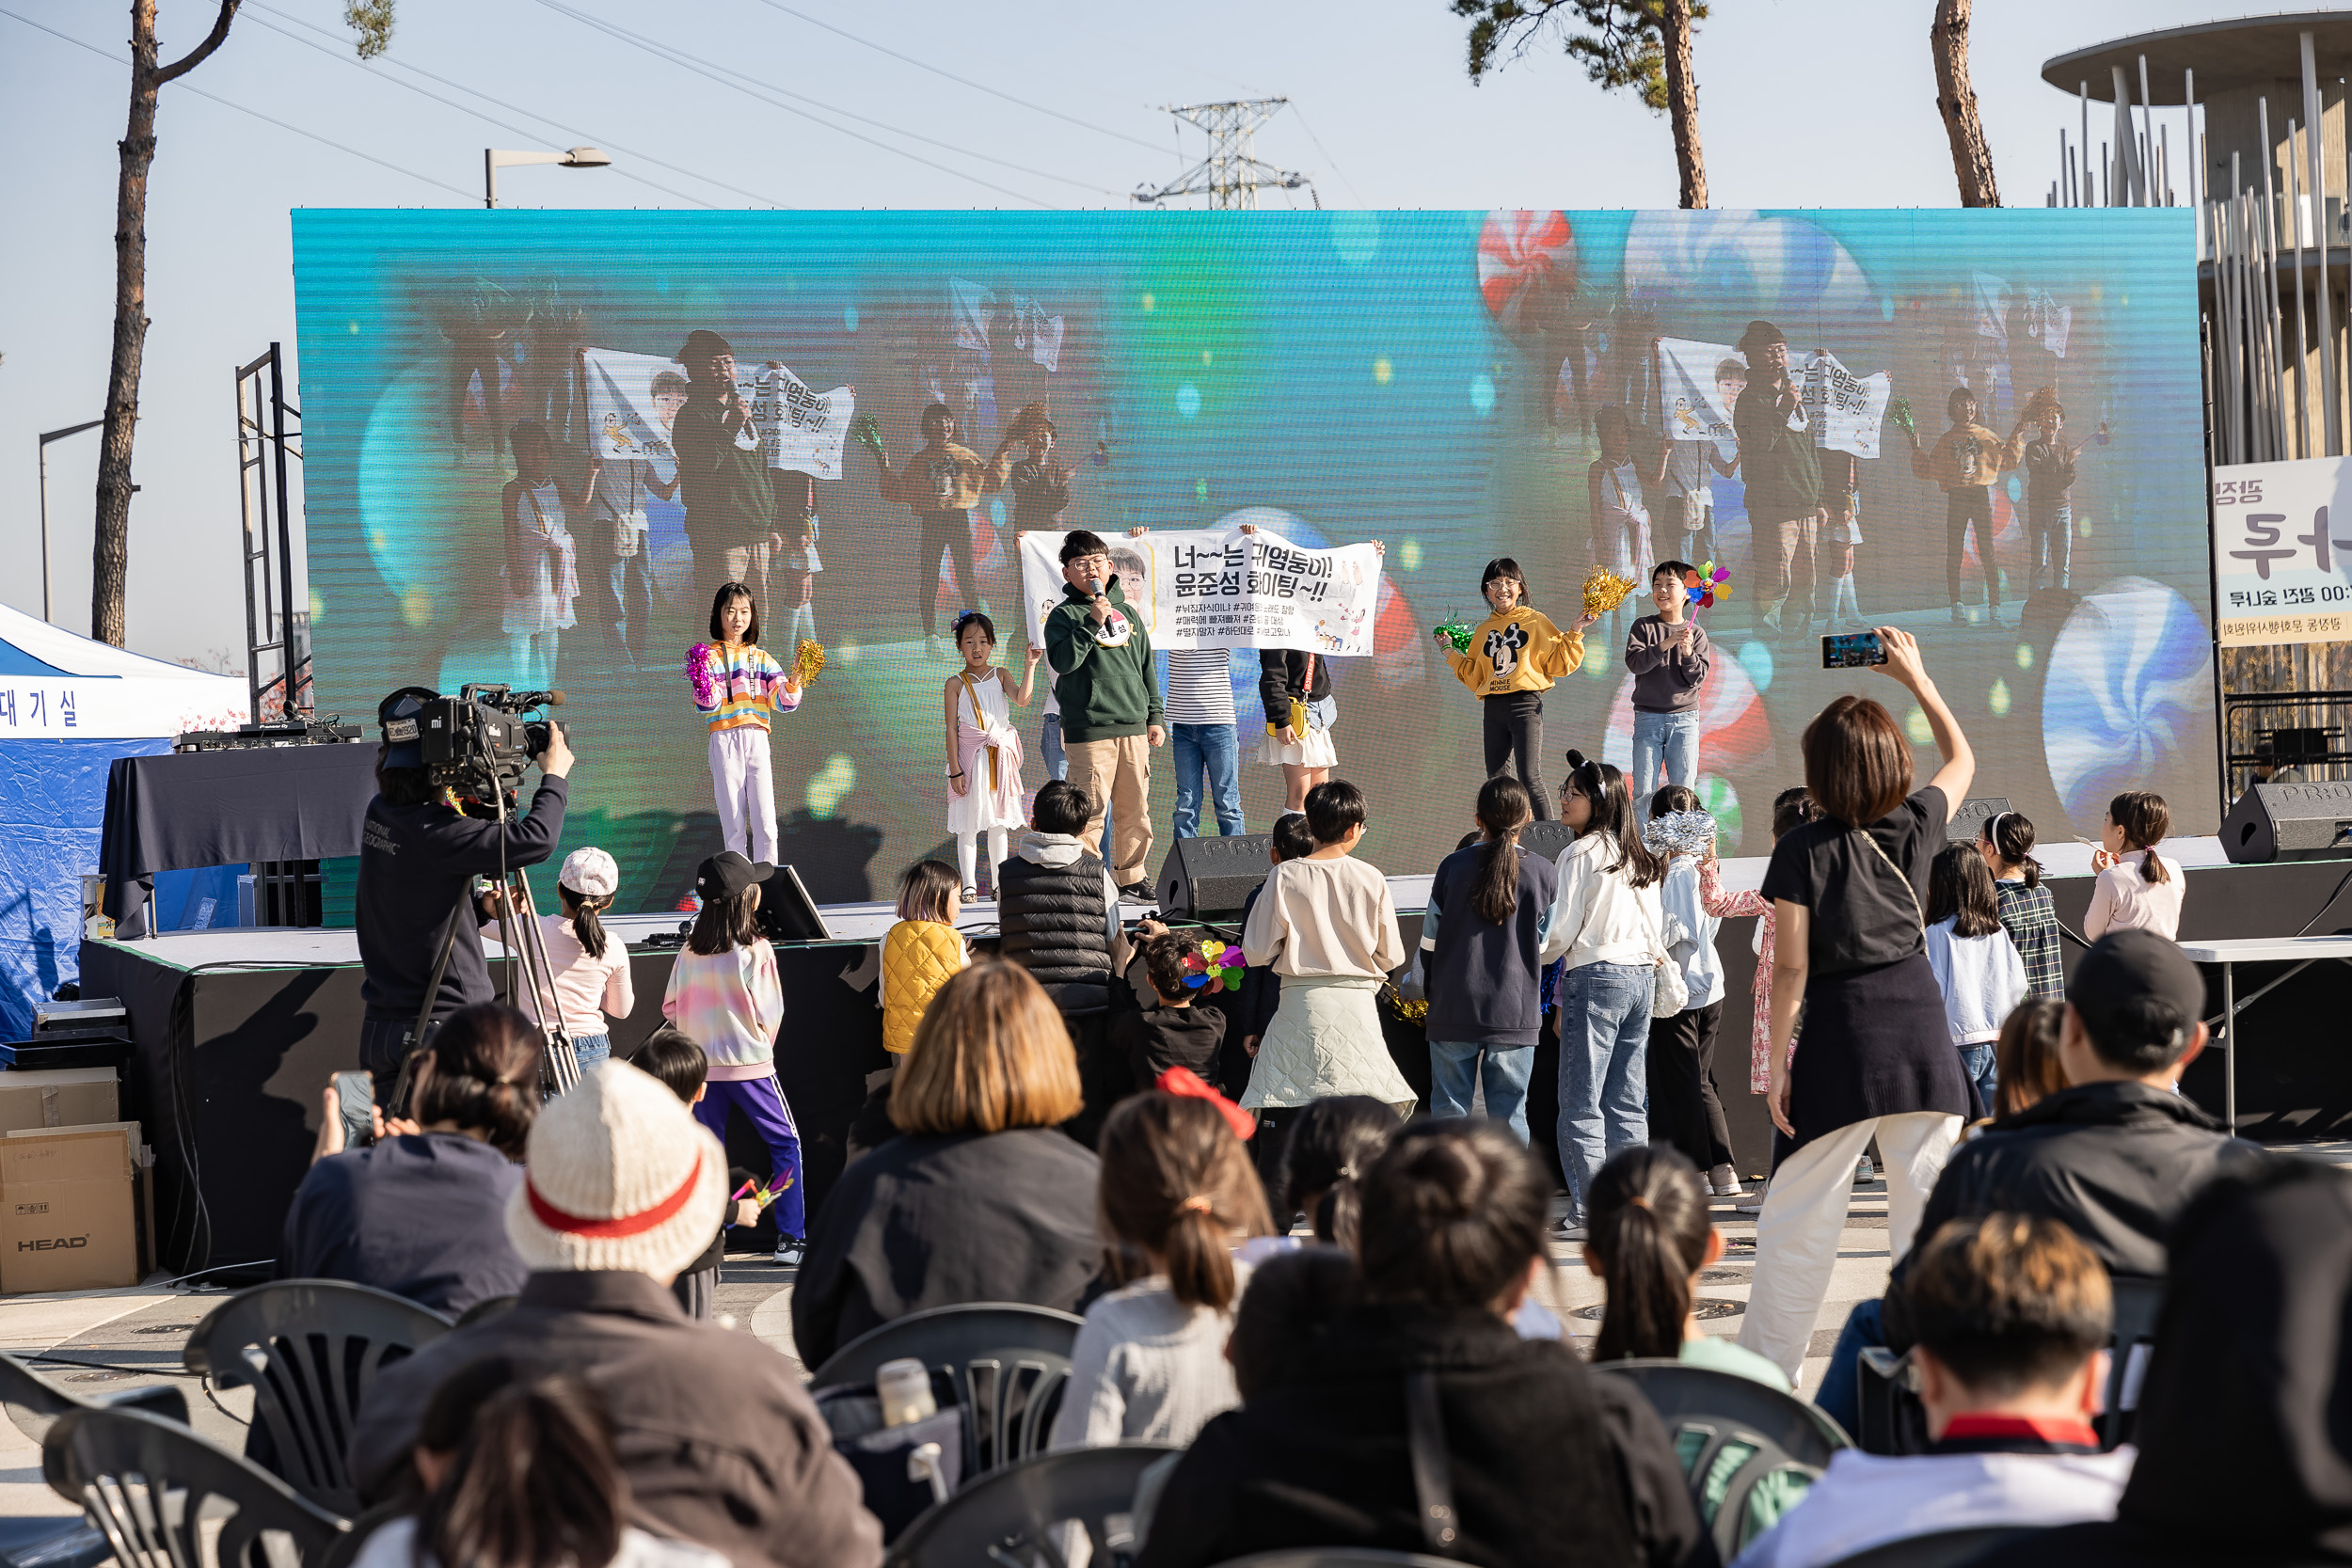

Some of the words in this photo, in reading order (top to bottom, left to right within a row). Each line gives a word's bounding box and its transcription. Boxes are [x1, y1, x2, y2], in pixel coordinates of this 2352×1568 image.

[1174, 544, 1245, 569] 너~~는
[1251, 543, 1333, 578] 귀염둥이!
[1175, 571, 1241, 598] 윤준성
[1175, 615, 1206, 626] #매력에
[1176, 626, 1216, 638] #떨지말자
[1489, 678, 1511, 687] MINNIE
[18, 1236, 87, 1253] HEAD
